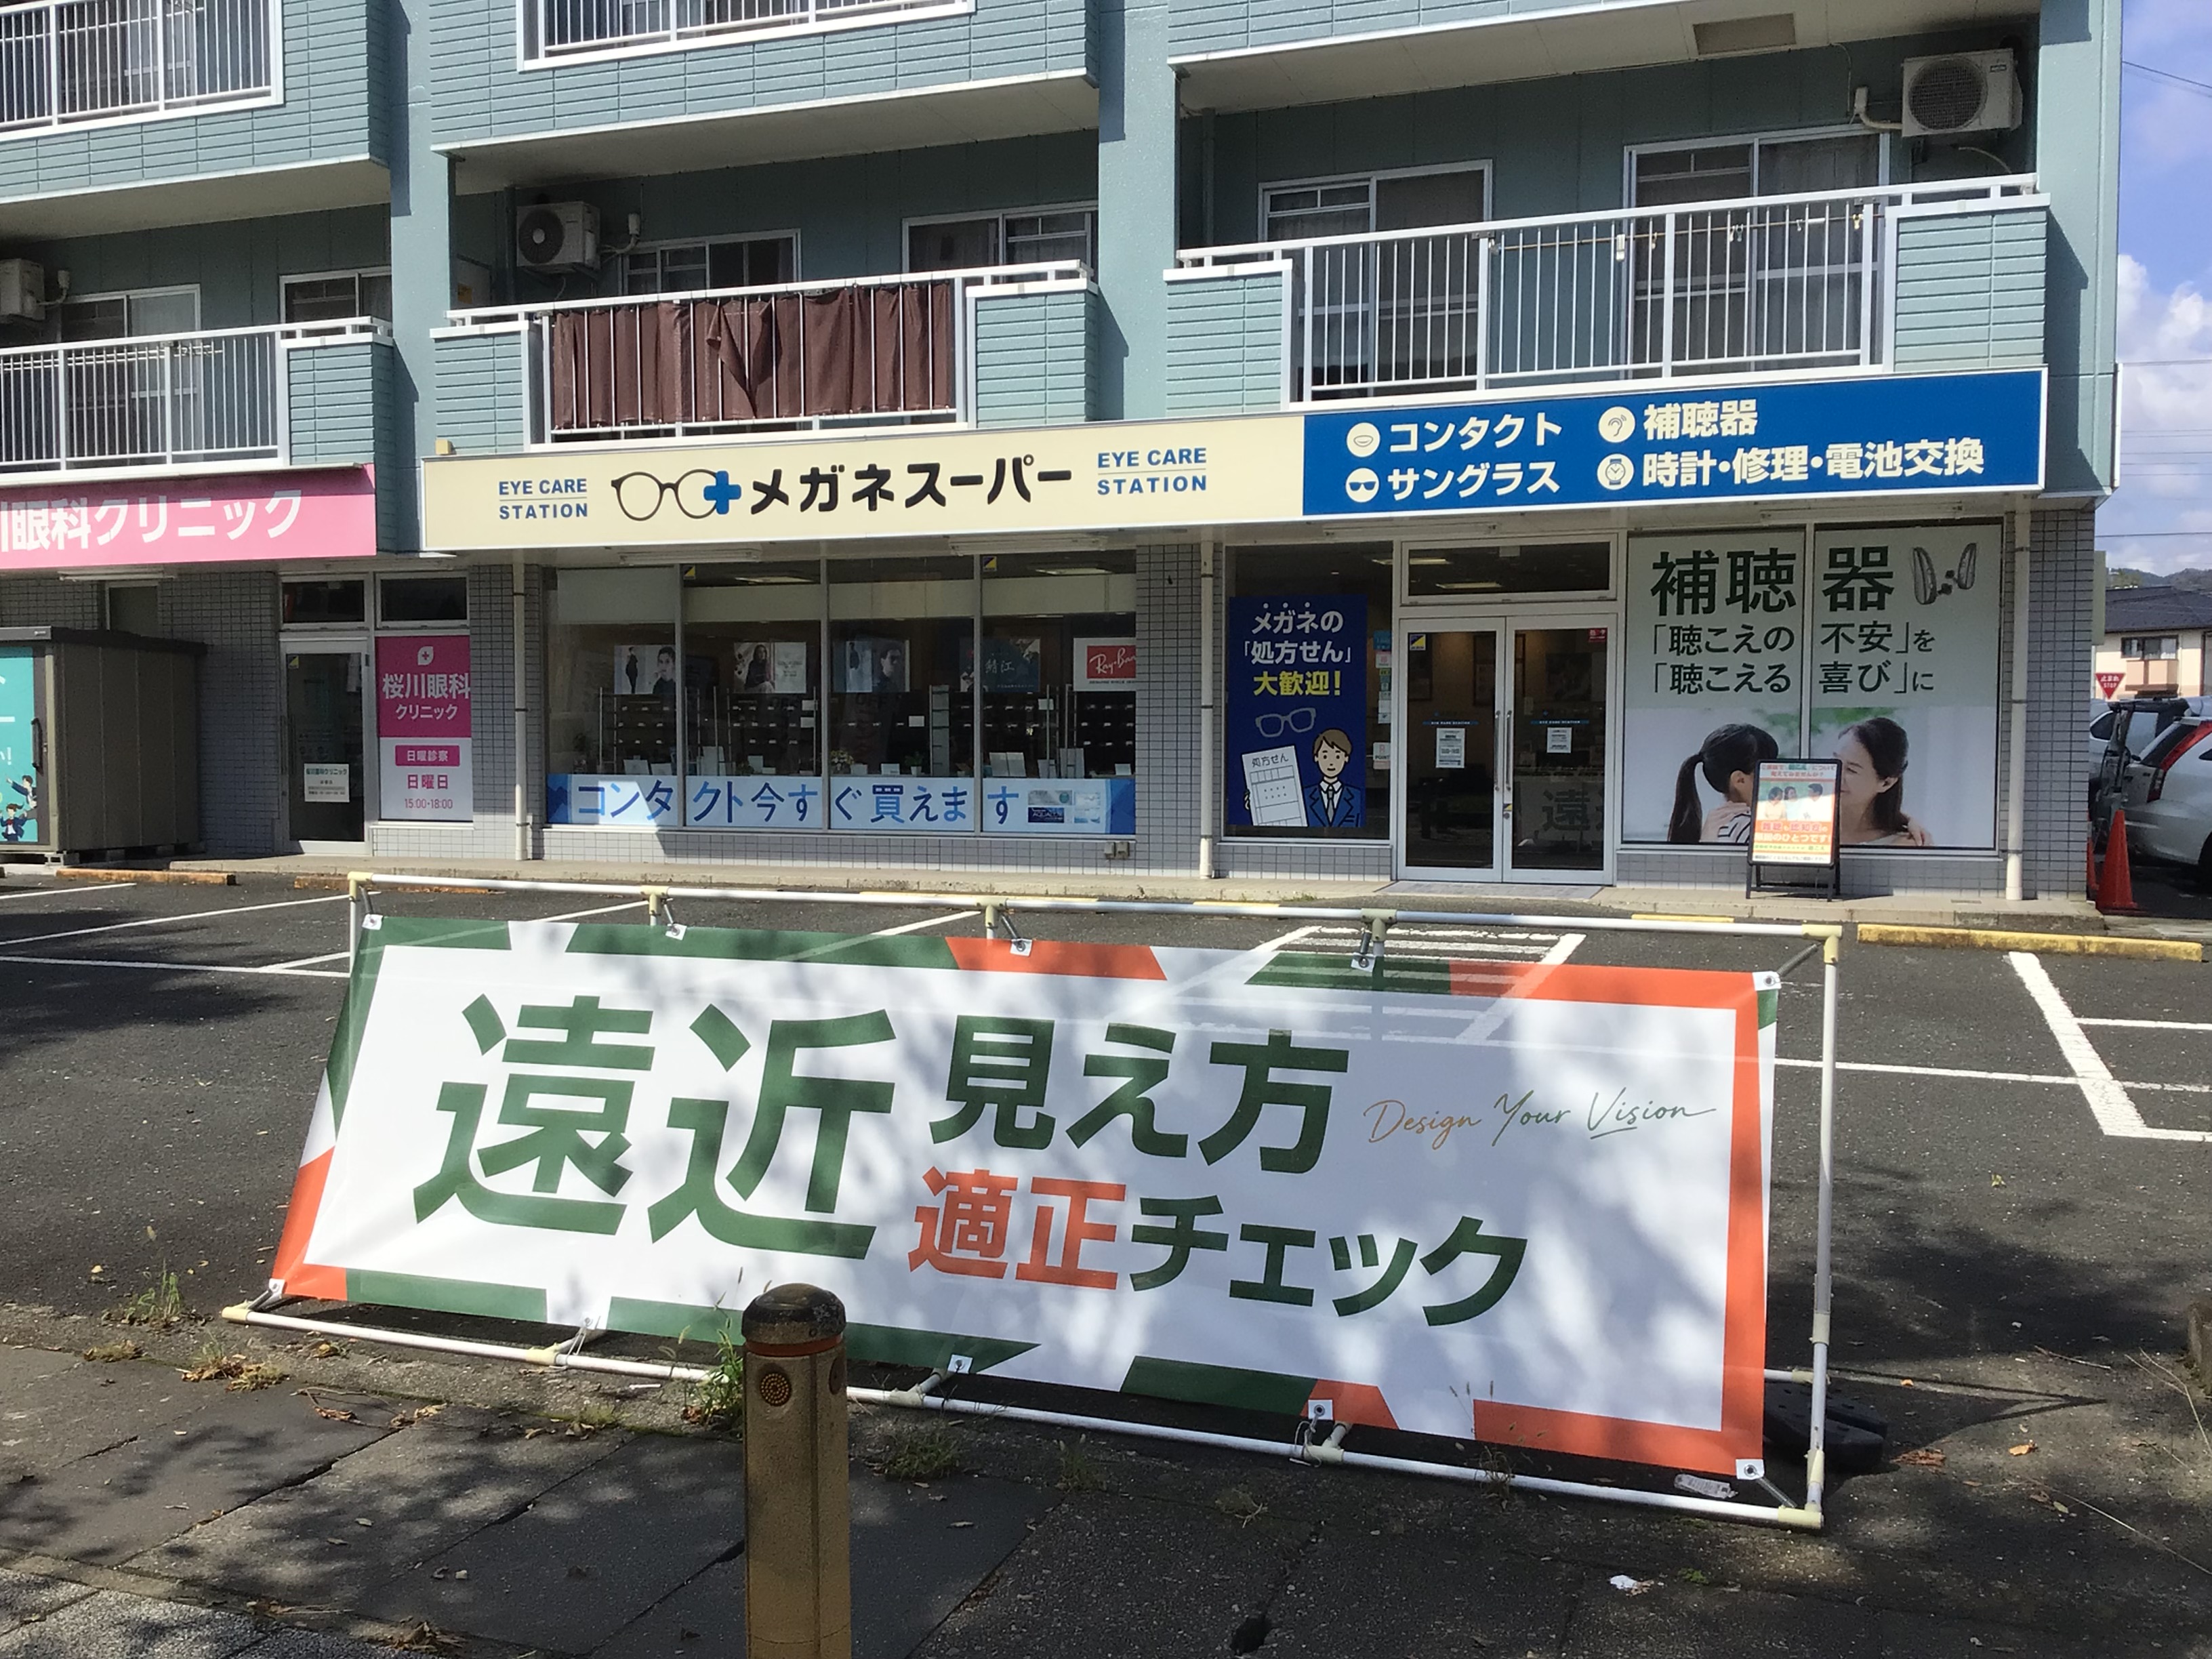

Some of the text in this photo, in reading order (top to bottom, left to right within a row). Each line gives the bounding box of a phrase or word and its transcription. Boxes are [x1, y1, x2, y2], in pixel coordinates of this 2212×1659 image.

[1389, 411, 1563, 452] コンタクト
[1643, 399, 1758, 441] 補聴器
[1097, 447, 1207, 468] EYE CARE
[1642, 437, 1984, 487] 時計・修理・電池交換
[499, 478, 588, 495] EYE CARE
[750, 454, 1072, 515] メガネスーパー
[1097, 475, 1207, 495] STATION
[1388, 460, 1561, 501] サングラス
[499, 503, 588, 520] STATION
[1650, 545, 1895, 616] 補聴器
[1252, 610, 1344, 634] メガネの
[1654, 620, 1936, 657] 「聴こえの不安」を
[1244, 640, 1351, 665] 「処方せん」
[382, 672, 471, 699] 桜川眼科
[1654, 659, 1935, 695] 「聴こえる喜び」に
[395, 703, 458, 720] クリニック
[407, 750, 448, 762] 日曜診察
[1252, 754, 1289, 768] 処方せん
[407, 775, 448, 790] 日曜日
[578, 779, 1019, 825] コンタクト今すぐ買えます
[413, 993, 1349, 1260] 遠近 見え方
[1363, 1086, 1717, 1150] Design Your Vision
[908, 1165, 1528, 1327] 適正チェック
